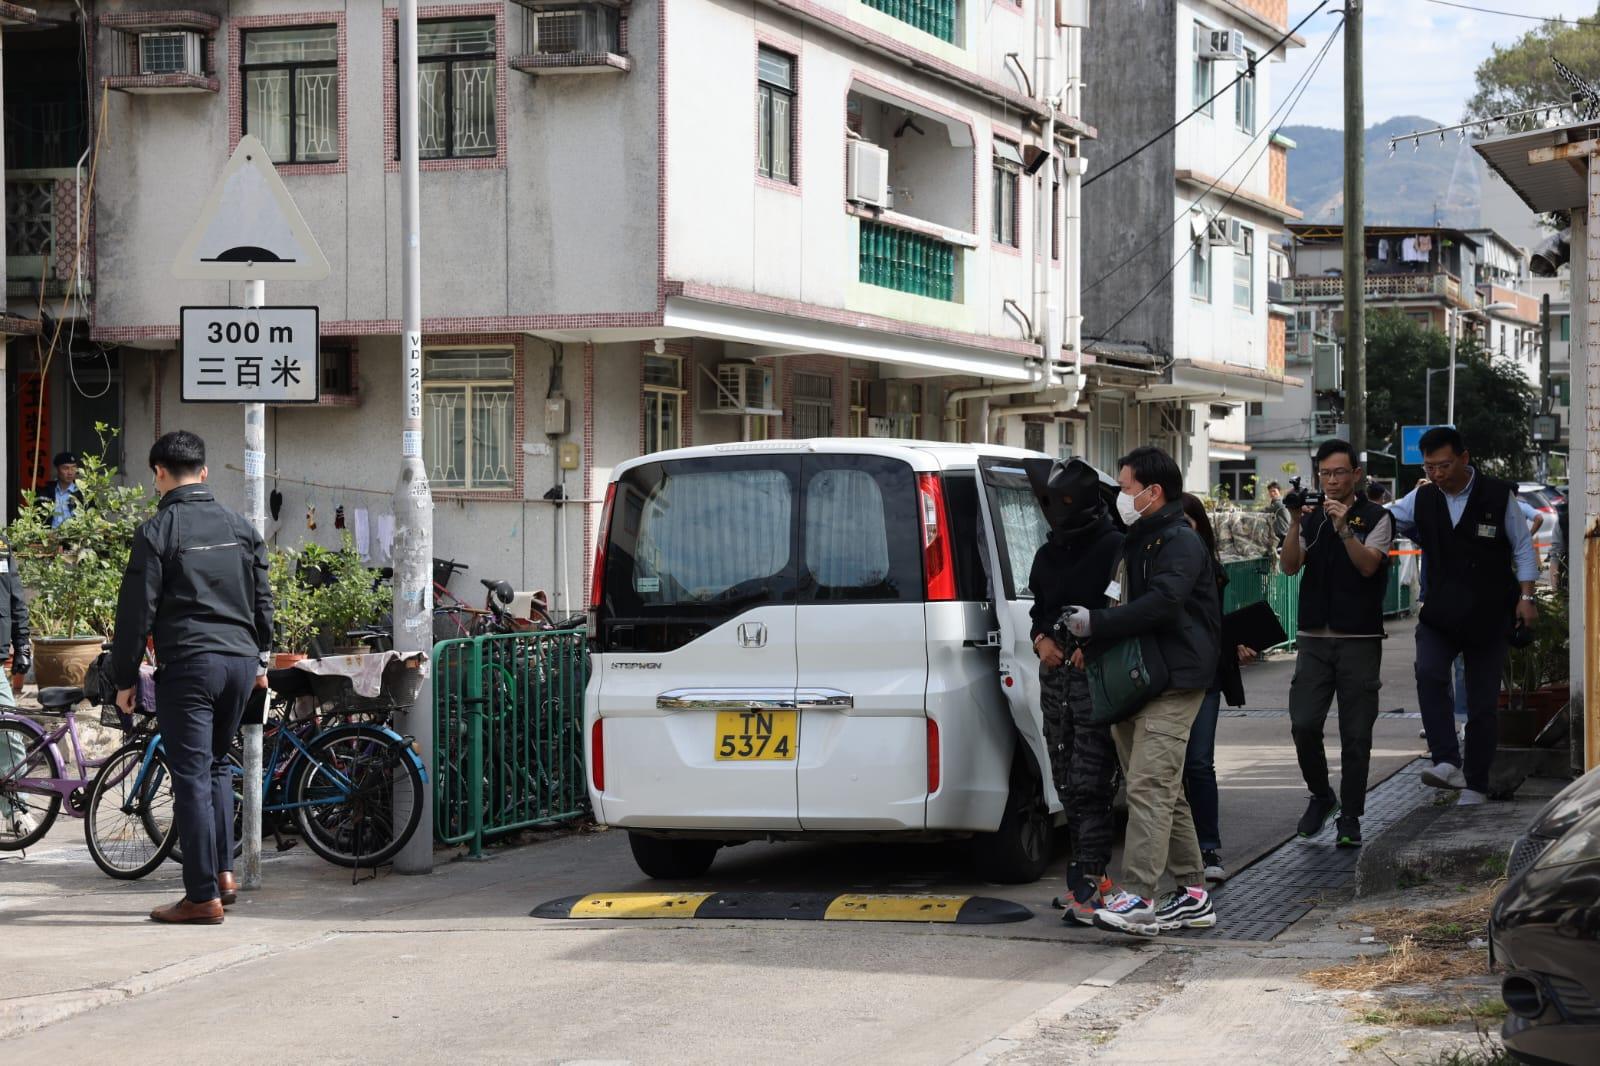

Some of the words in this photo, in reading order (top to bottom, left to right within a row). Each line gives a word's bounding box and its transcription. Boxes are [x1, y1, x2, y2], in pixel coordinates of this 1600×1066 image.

[207, 321, 260, 343] 300
[269, 325, 293, 343] m
[411, 335, 420, 359] VD
[197, 355, 301, 387] 三百米
[410, 367, 420, 416] 2439
[739, 713, 773, 735] TN
[720, 735, 789, 757] 5374
